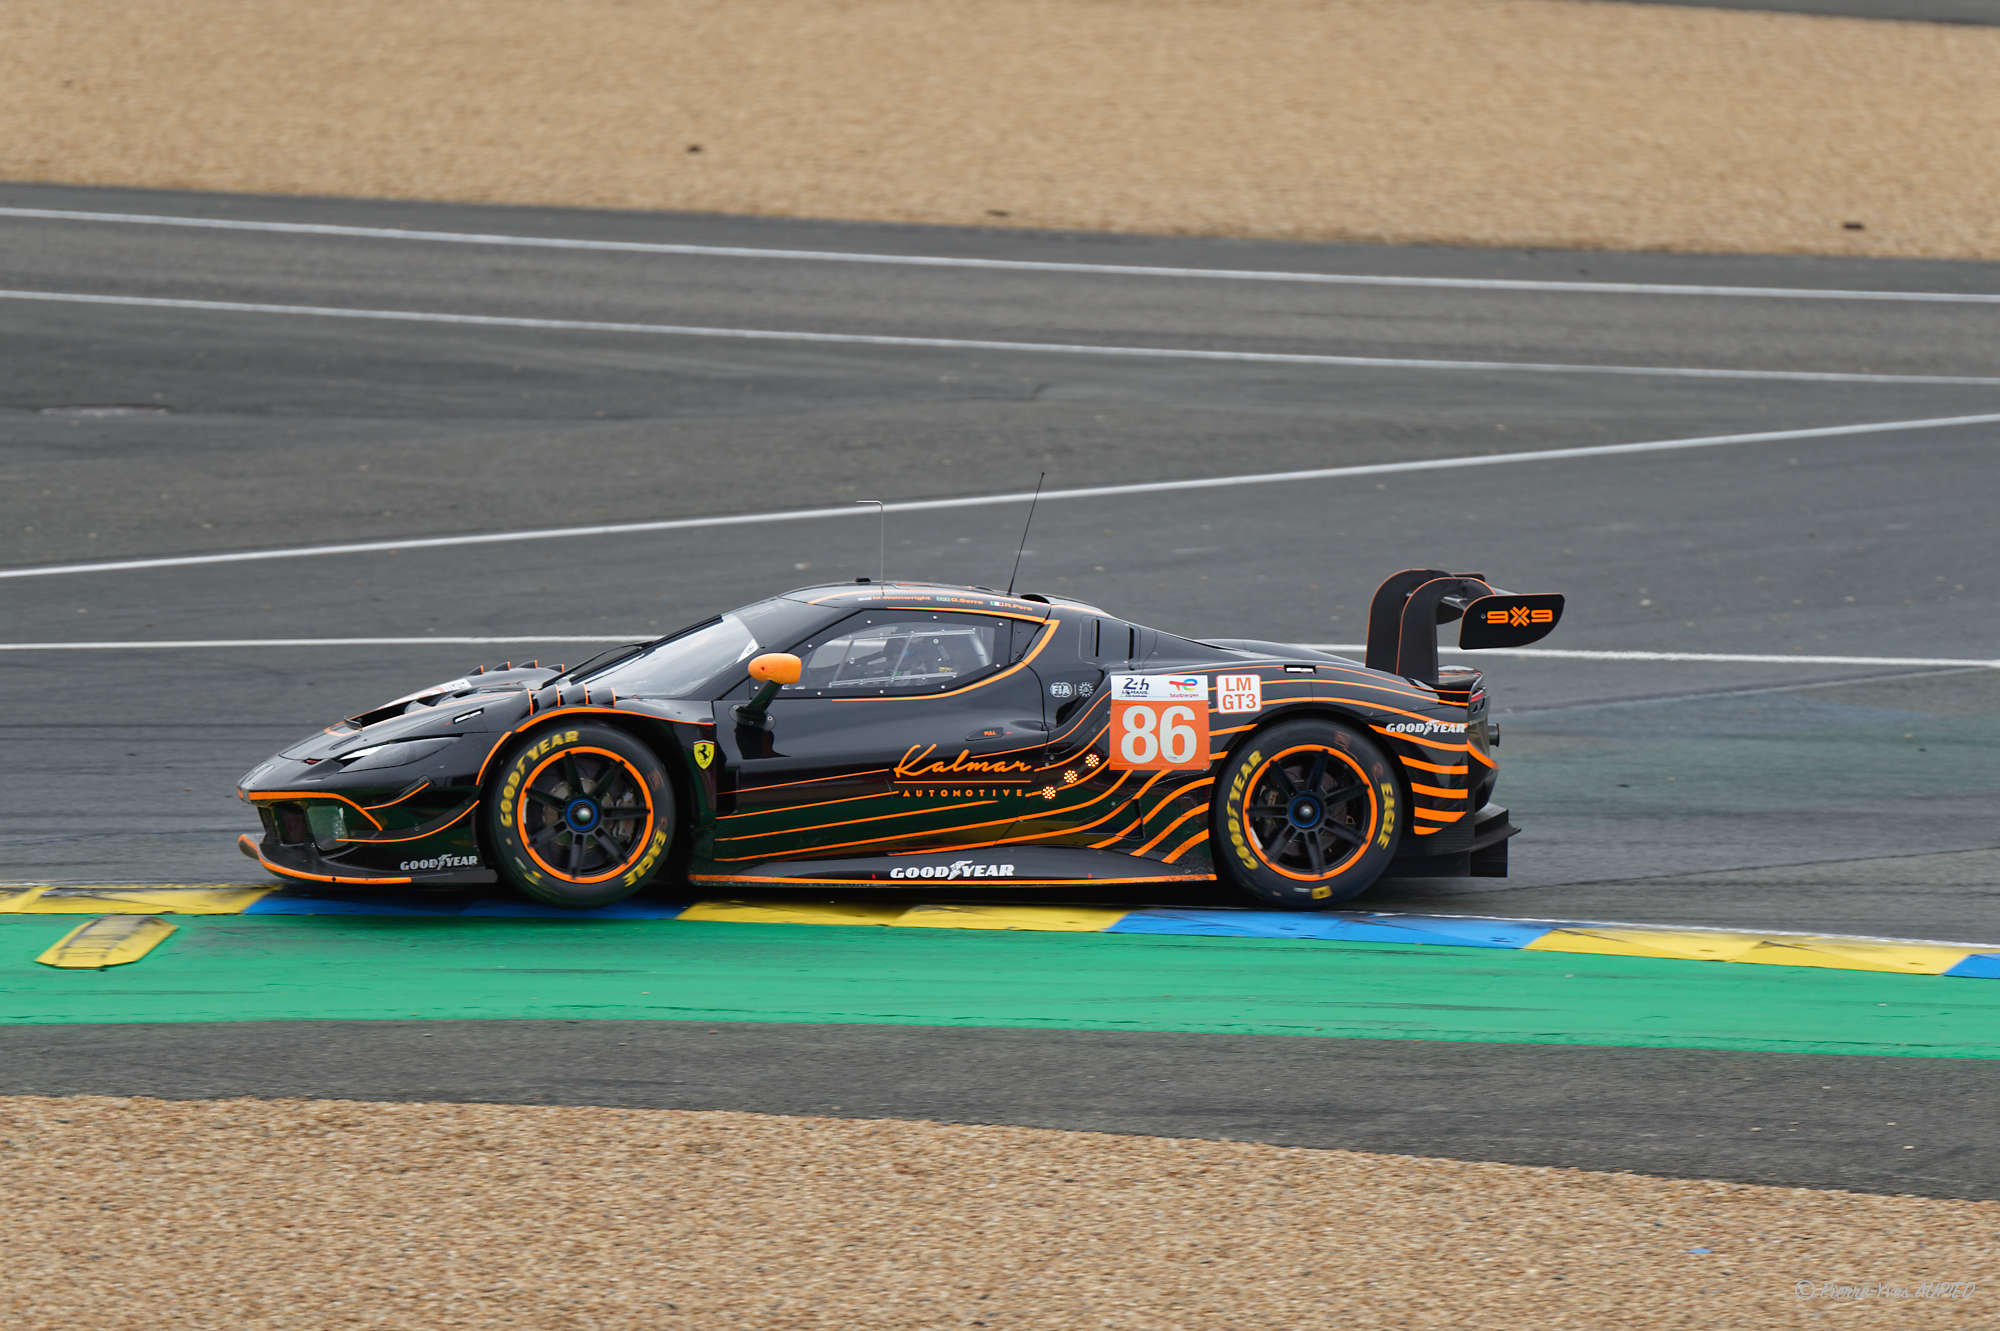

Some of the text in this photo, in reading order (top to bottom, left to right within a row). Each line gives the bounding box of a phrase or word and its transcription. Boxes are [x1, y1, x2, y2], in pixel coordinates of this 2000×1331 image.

[1487, 606, 1553, 627] 9X9
[1225, 677, 1252, 691] LM
[1222, 694, 1256, 710] GT3
[1120, 705, 1197, 764] 86
[1386, 720, 1466, 735] GOODYEAR
[893, 744, 1032, 778] Kalmar
[500, 730, 580, 828] GOODYEAR
[903, 788, 1022, 798] AUTOMOTIVE
[1227, 750, 1263, 870] GOODYEAR
[400, 854, 478, 871] GOODYEAR
[890, 860, 1015, 880] GOODYEAR
